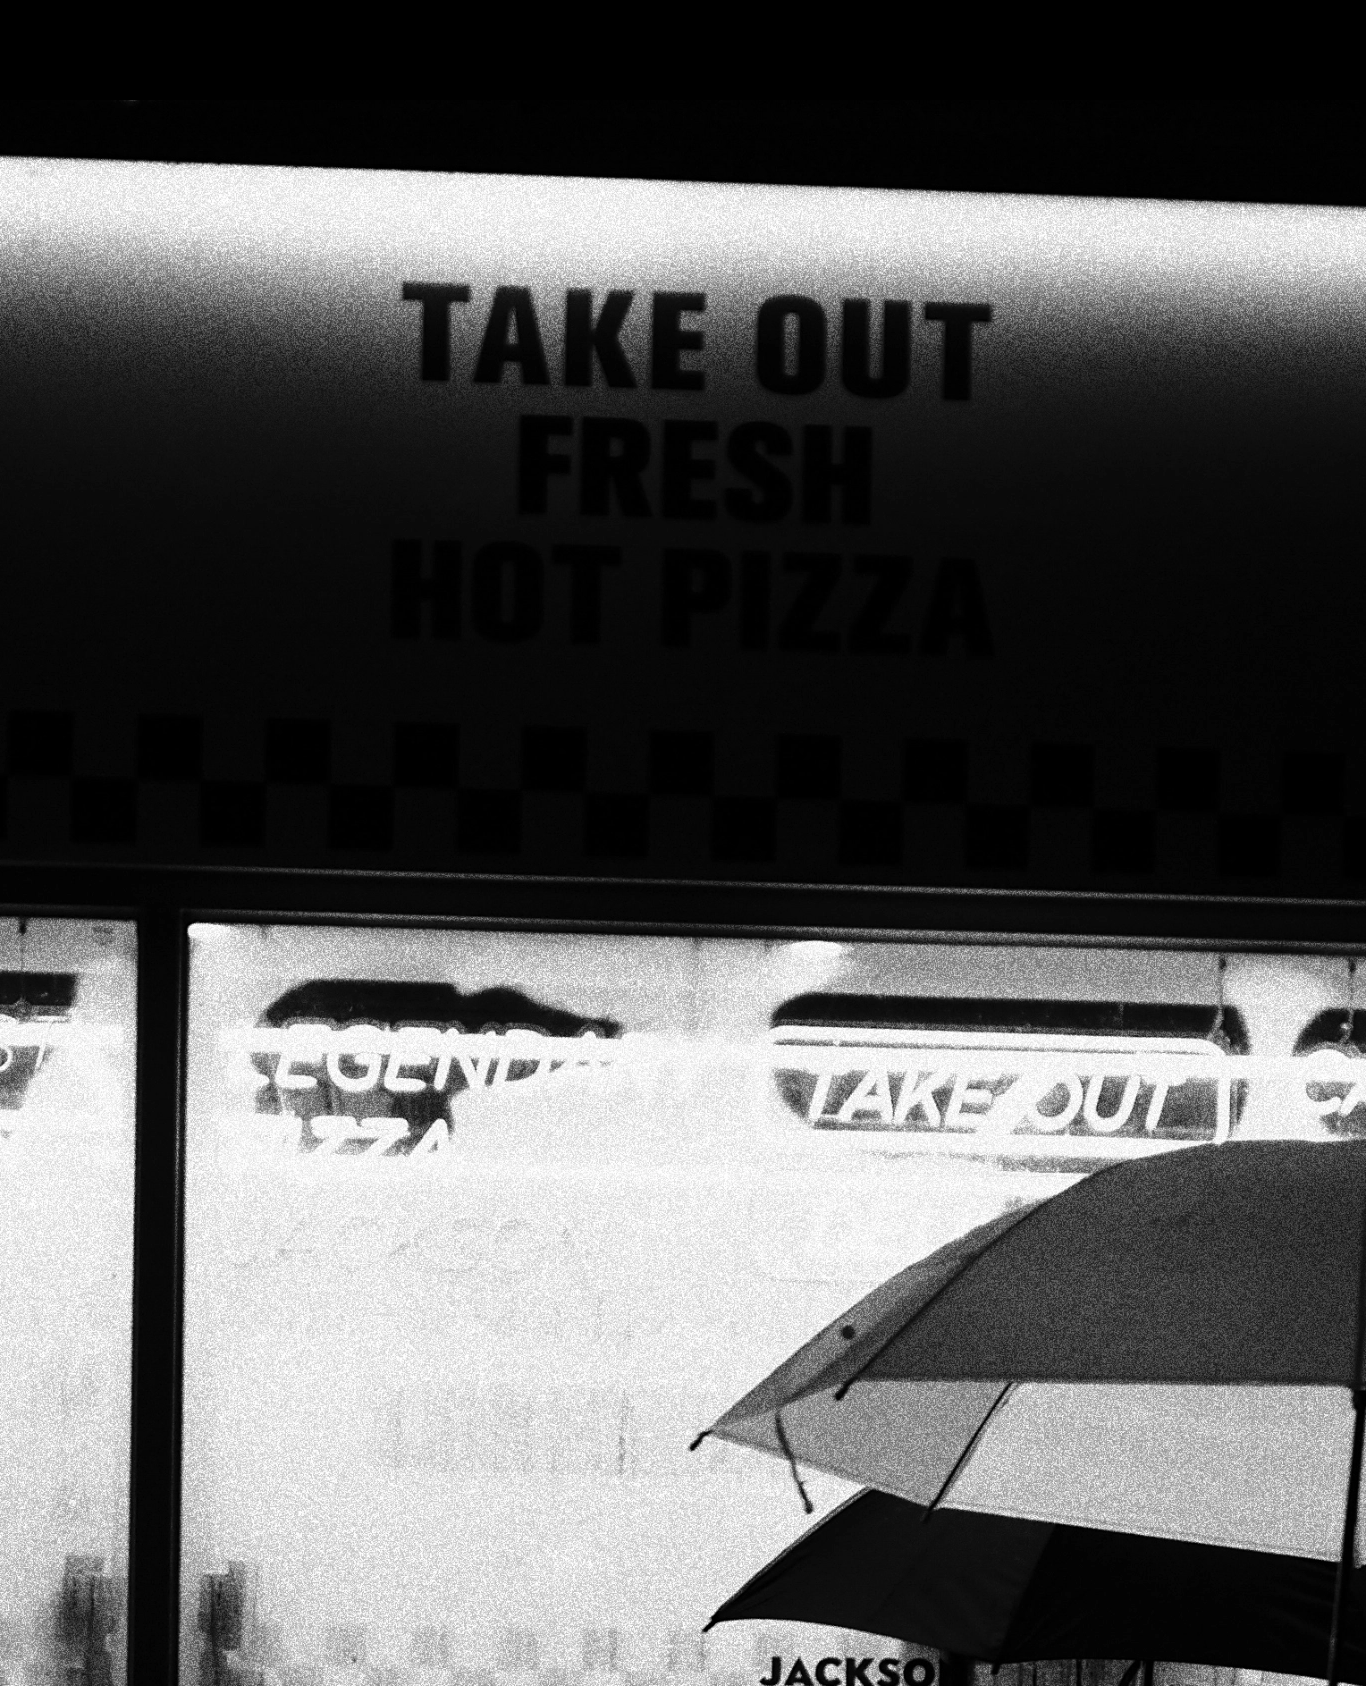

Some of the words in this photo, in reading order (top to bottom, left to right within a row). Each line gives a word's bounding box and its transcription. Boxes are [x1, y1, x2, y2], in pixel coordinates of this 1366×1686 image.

[402, 281, 707, 390] TAKE
[756, 294, 993, 401] OUT
[518, 414, 873, 525] FRESH
[390, 538, 623, 645] HOT
[661, 547, 995, 658] PIZZA
